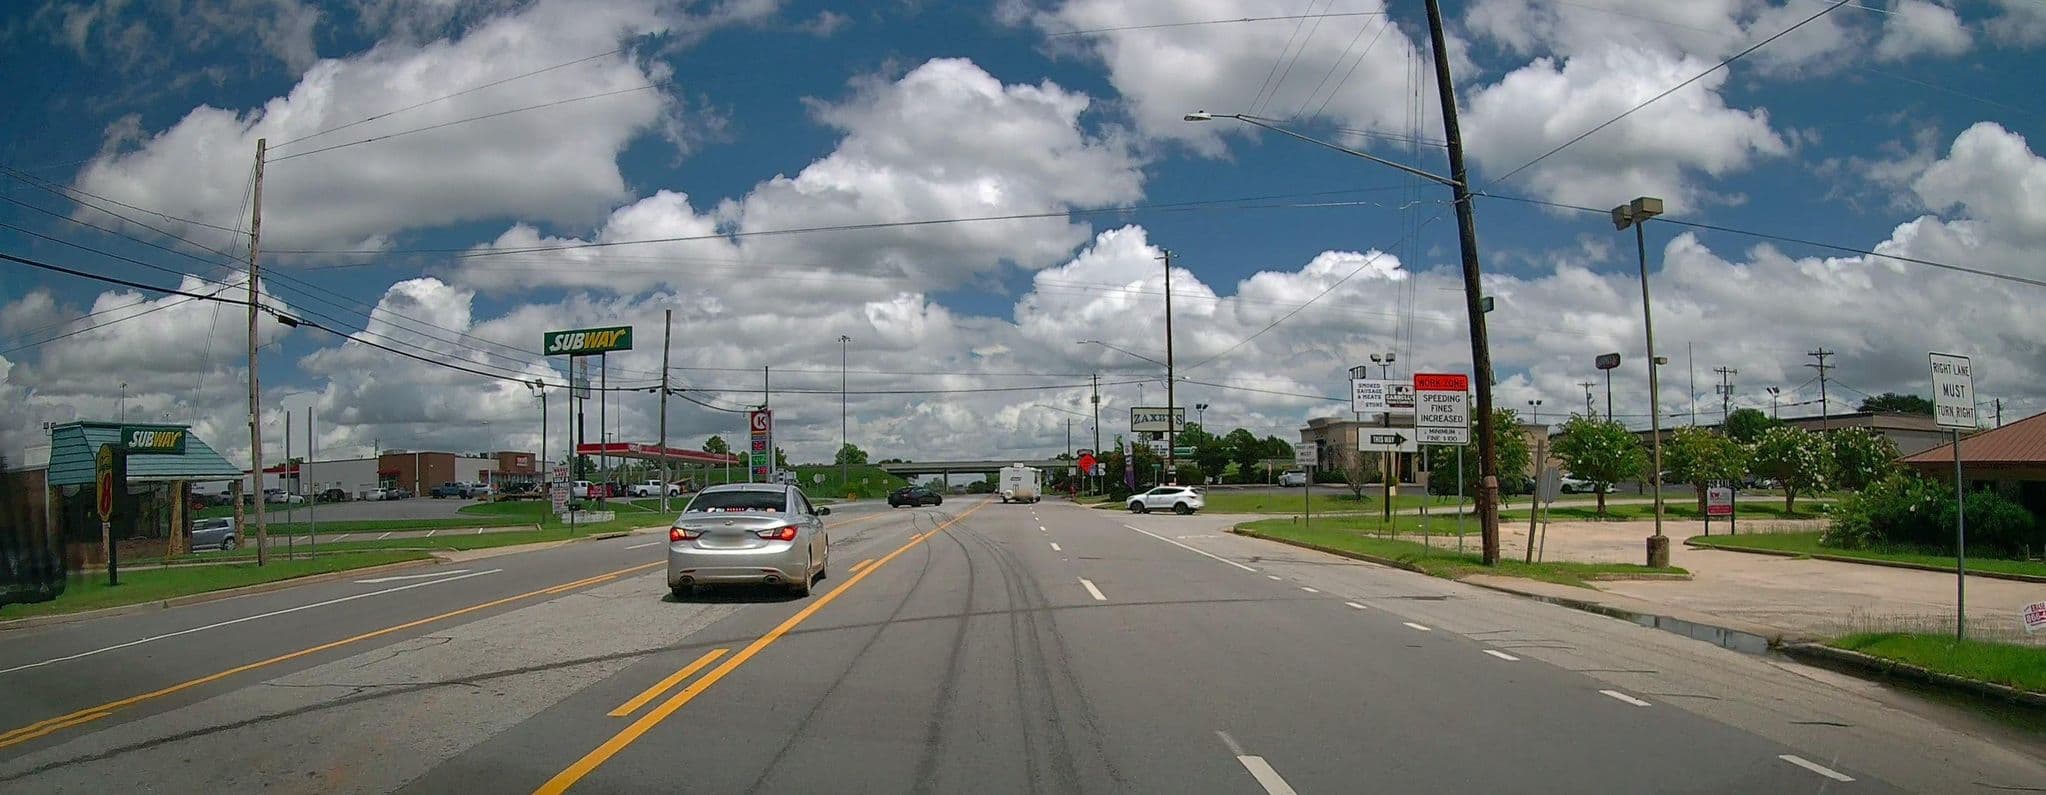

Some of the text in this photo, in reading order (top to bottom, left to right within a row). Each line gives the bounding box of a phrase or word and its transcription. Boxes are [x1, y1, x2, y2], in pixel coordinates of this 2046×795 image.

[549, 329, 626, 352] SUBWAY
[1933, 363, 1969, 376] RIGHT LANE
[1942, 383, 1966, 399] MUST
[1423, 394, 1461, 403] SPEEDING
[1431, 404, 1453, 413] FINES
[1937, 404, 1974, 420] TURN RIGHT
[758, 417, 766, 426] K
[1420, 414, 1464, 423] INCREASED
[128, 431, 182, 448] SUBWAY
